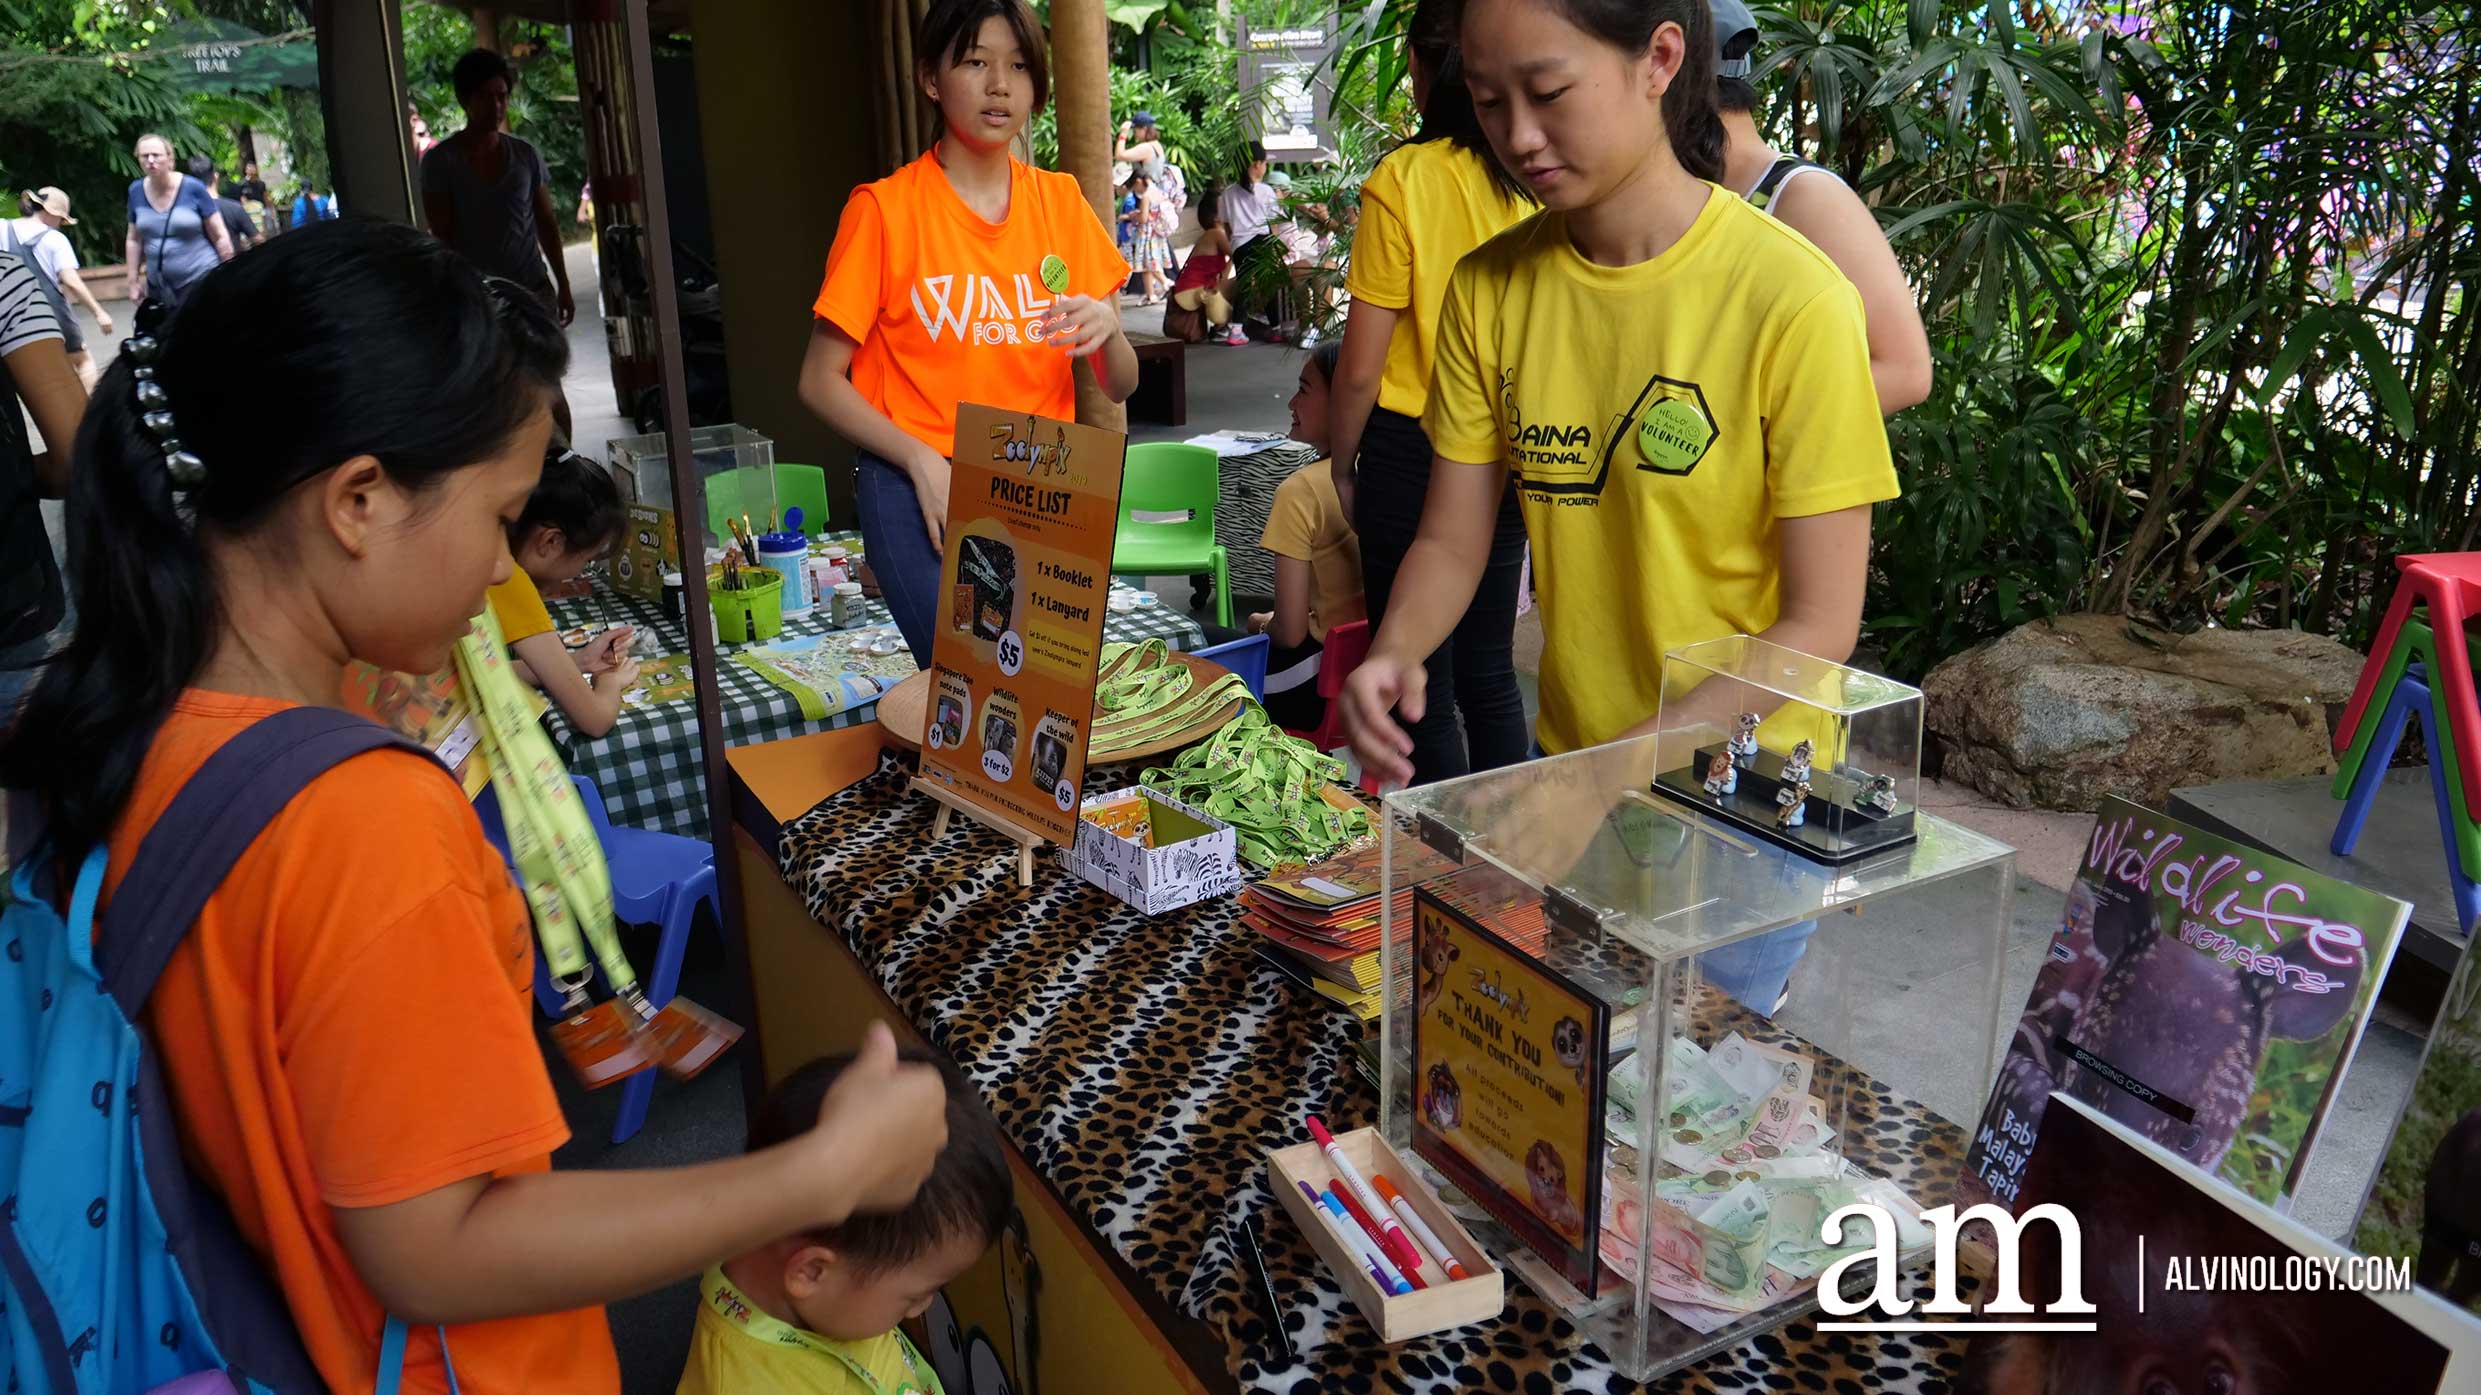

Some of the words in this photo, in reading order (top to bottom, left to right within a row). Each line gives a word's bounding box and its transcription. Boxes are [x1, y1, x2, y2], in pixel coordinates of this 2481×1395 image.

[911, 274, 1063, 343] WAL
[973, 322, 1021, 345] FOR
[1641, 421, 1699, 457] VOLUNTEER
[991, 476, 1034, 507] PRICE
[1037, 490, 1072, 515] LIST
[1527, 493, 1553, 504] YOUR
[1557, 497, 1599, 506] POWER
[1037, 561, 1043, 575] 1
[1044, 565, 1051, 577] x
[1053, 564, 1094, 589] Booklet
[1031, 591, 1037, 605] 1
[1038, 595, 1044, 608] x
[1046, 596, 1090, 622] Lanyard
[997, 639, 1020, 668] $5
[952, 684, 966, 698] pads
[993, 686, 1018, 703] Wildlife
[989, 702, 1016, 719] wonders
[1045, 706, 1070, 724] Keeper
[1071, 717, 1079, 727] of
[930, 728, 941, 743] $1
[1046, 725, 1058, 737] the
[1058, 730, 1074, 743] wild
[983, 756, 988, 766] 3
[989, 759, 1000, 771] for
[1000, 764, 1010, 776] $2
[1058, 786, 1072, 804] $5
[2089, 816, 2365, 966] Wildlife
[2180, 919, 2346, 994] wonders
[1438, 1009, 1455, 1031] FOR
[1459, 1022, 1483, 1051] YOUR
[1451, 989, 1504, 1043] THANK
[1511, 1030, 1541, 1067] YOU
[1465, 1063, 1478, 1077] All
[1480, 1075, 1524, 1112] proceeds
[2074, 1048, 2124, 1085] BROWSING
[2124, 1079, 2159, 1102] COPY
[1479, 1092, 1494, 1109] will
[1497, 1106, 1509, 1121] go
[1474, 1107, 1511, 1141] towards
[1468, 1121, 1514, 1160] education
[1978, 1124, 2028, 1177] Malay
